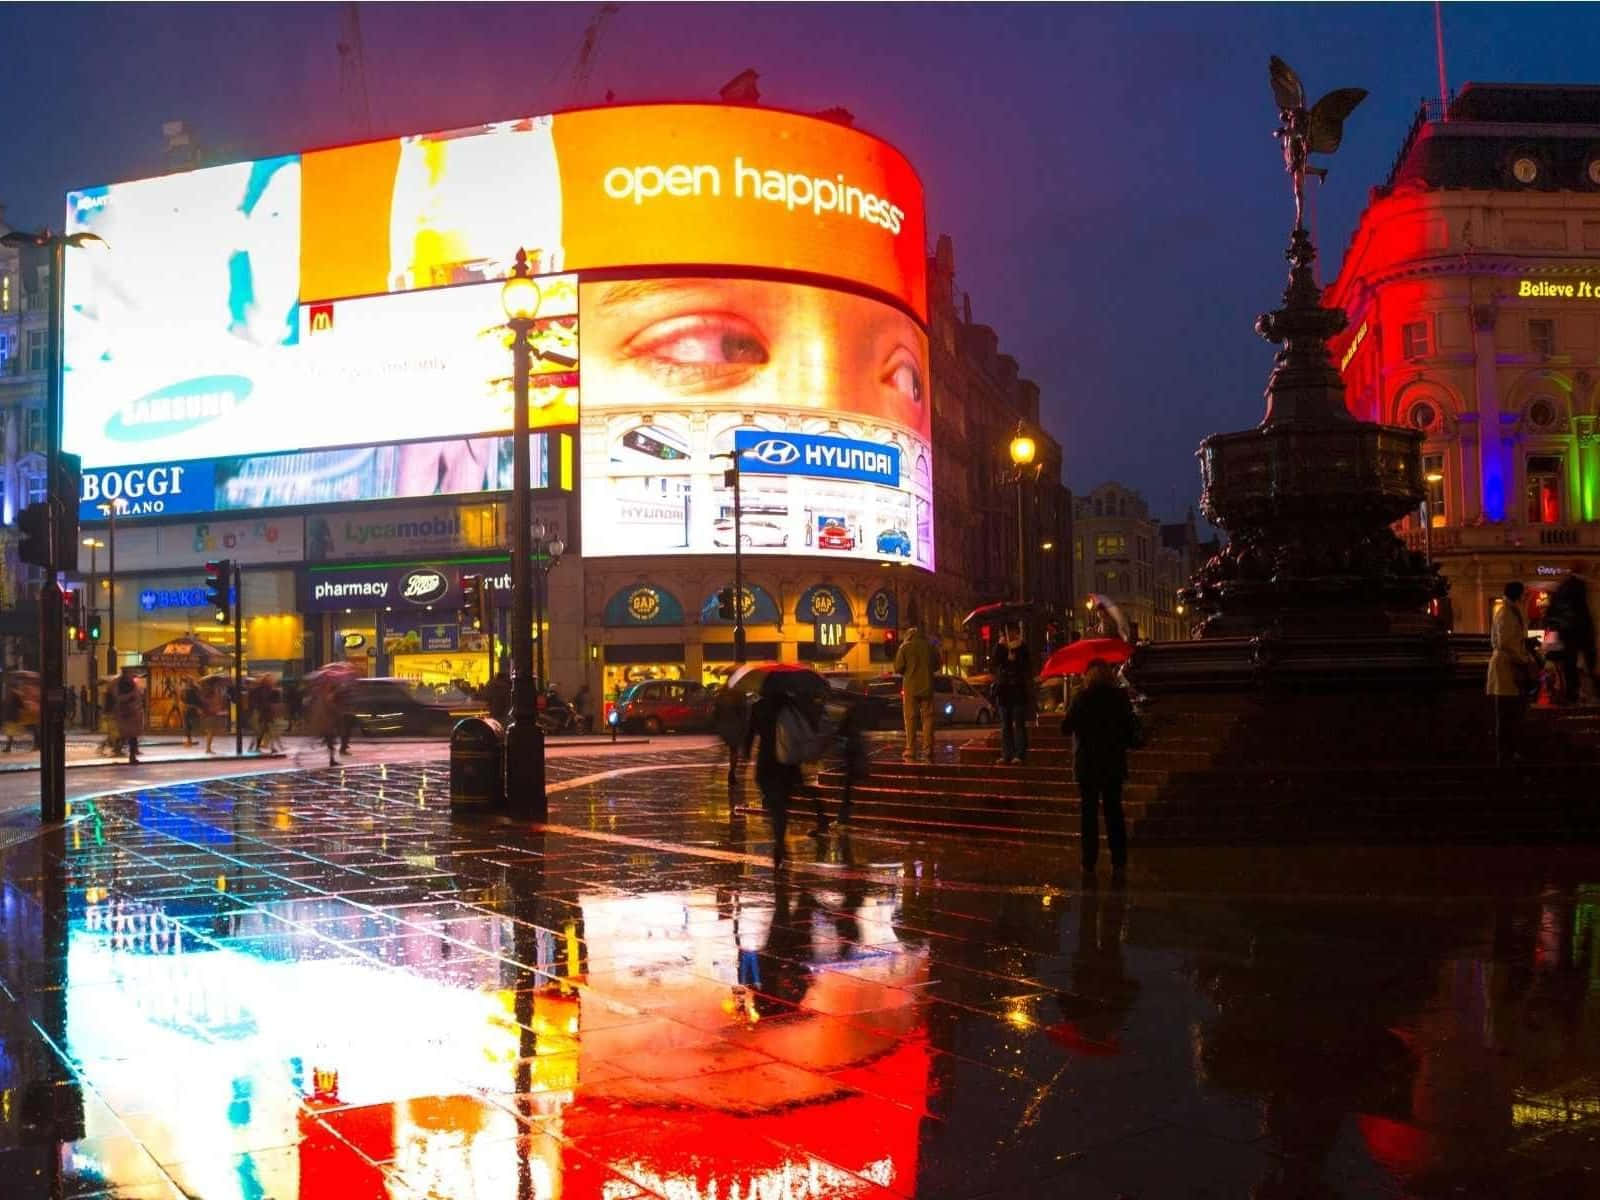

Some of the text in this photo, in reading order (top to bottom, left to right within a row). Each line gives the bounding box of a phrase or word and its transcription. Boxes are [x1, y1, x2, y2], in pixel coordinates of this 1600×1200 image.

[604, 156, 901, 234] open happiness
[1518, 280, 1574, 297] Believe
[1577, 281, 1592, 298] It
[123, 391, 233, 426] SAMSUNG
[805, 445, 892, 475] HYUNDAI
[81, 466, 184, 501] BOGGI
[345, 515, 466, 545] Lycamobil
[315, 580, 389, 600] pharmacy
[404, 575, 440, 596] Boots
[633, 596, 655, 609] GAP
[815, 596, 832, 609] GAP
[821, 624, 842, 646] GAP
